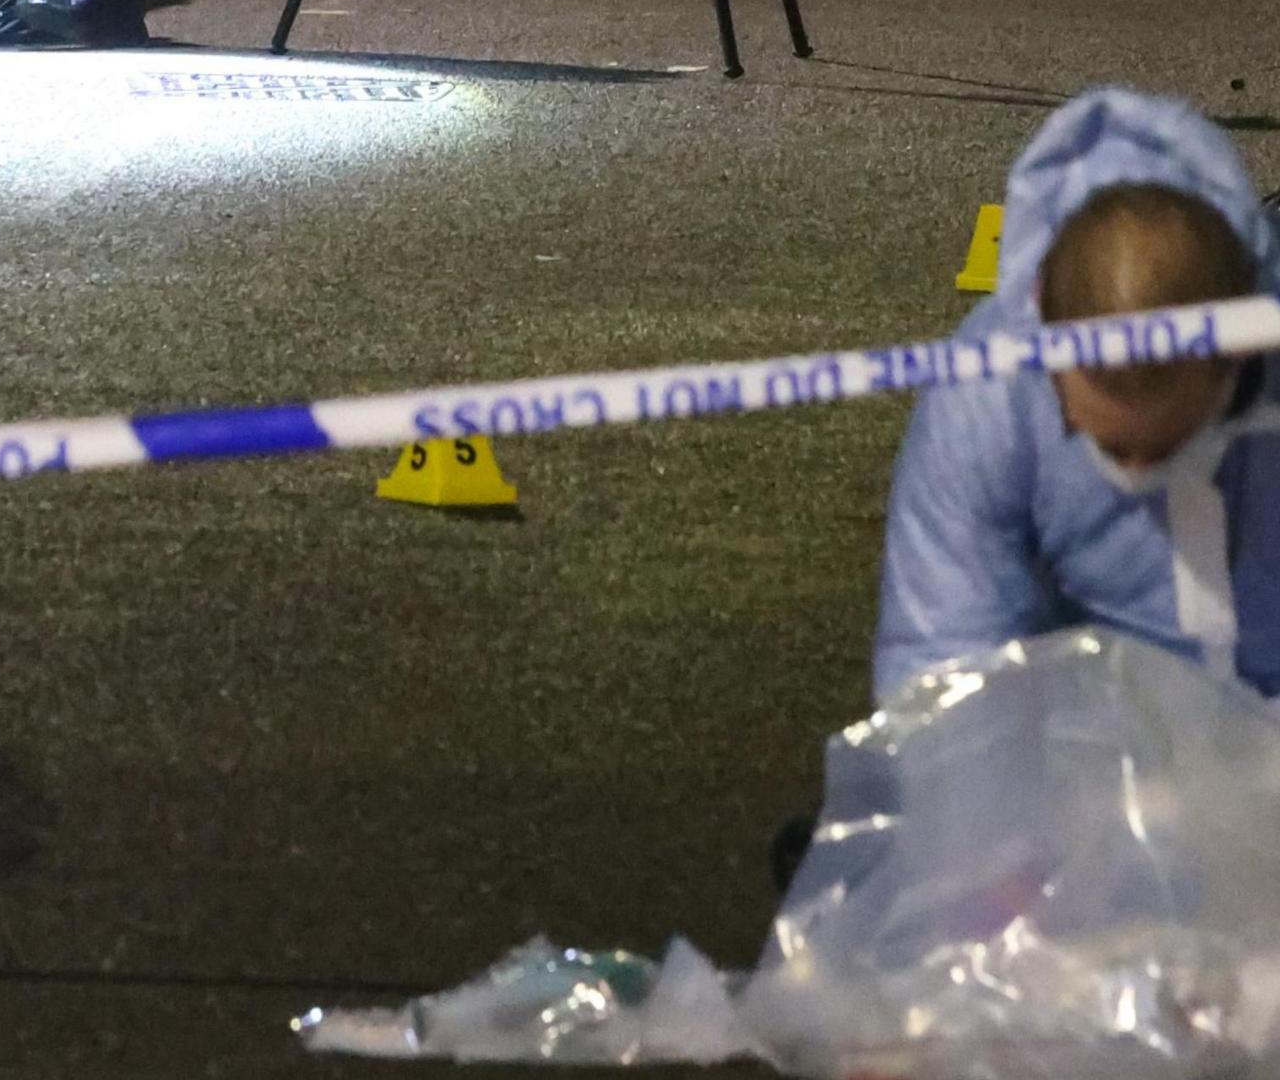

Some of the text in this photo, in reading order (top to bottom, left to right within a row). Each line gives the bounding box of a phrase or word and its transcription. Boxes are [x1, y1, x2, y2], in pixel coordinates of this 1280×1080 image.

[414, 314, 1217, 436] POLICE LINE DO NOT CROSS
[411, 442, 427, 470] 5
[455, 438, 477, 465] 5
